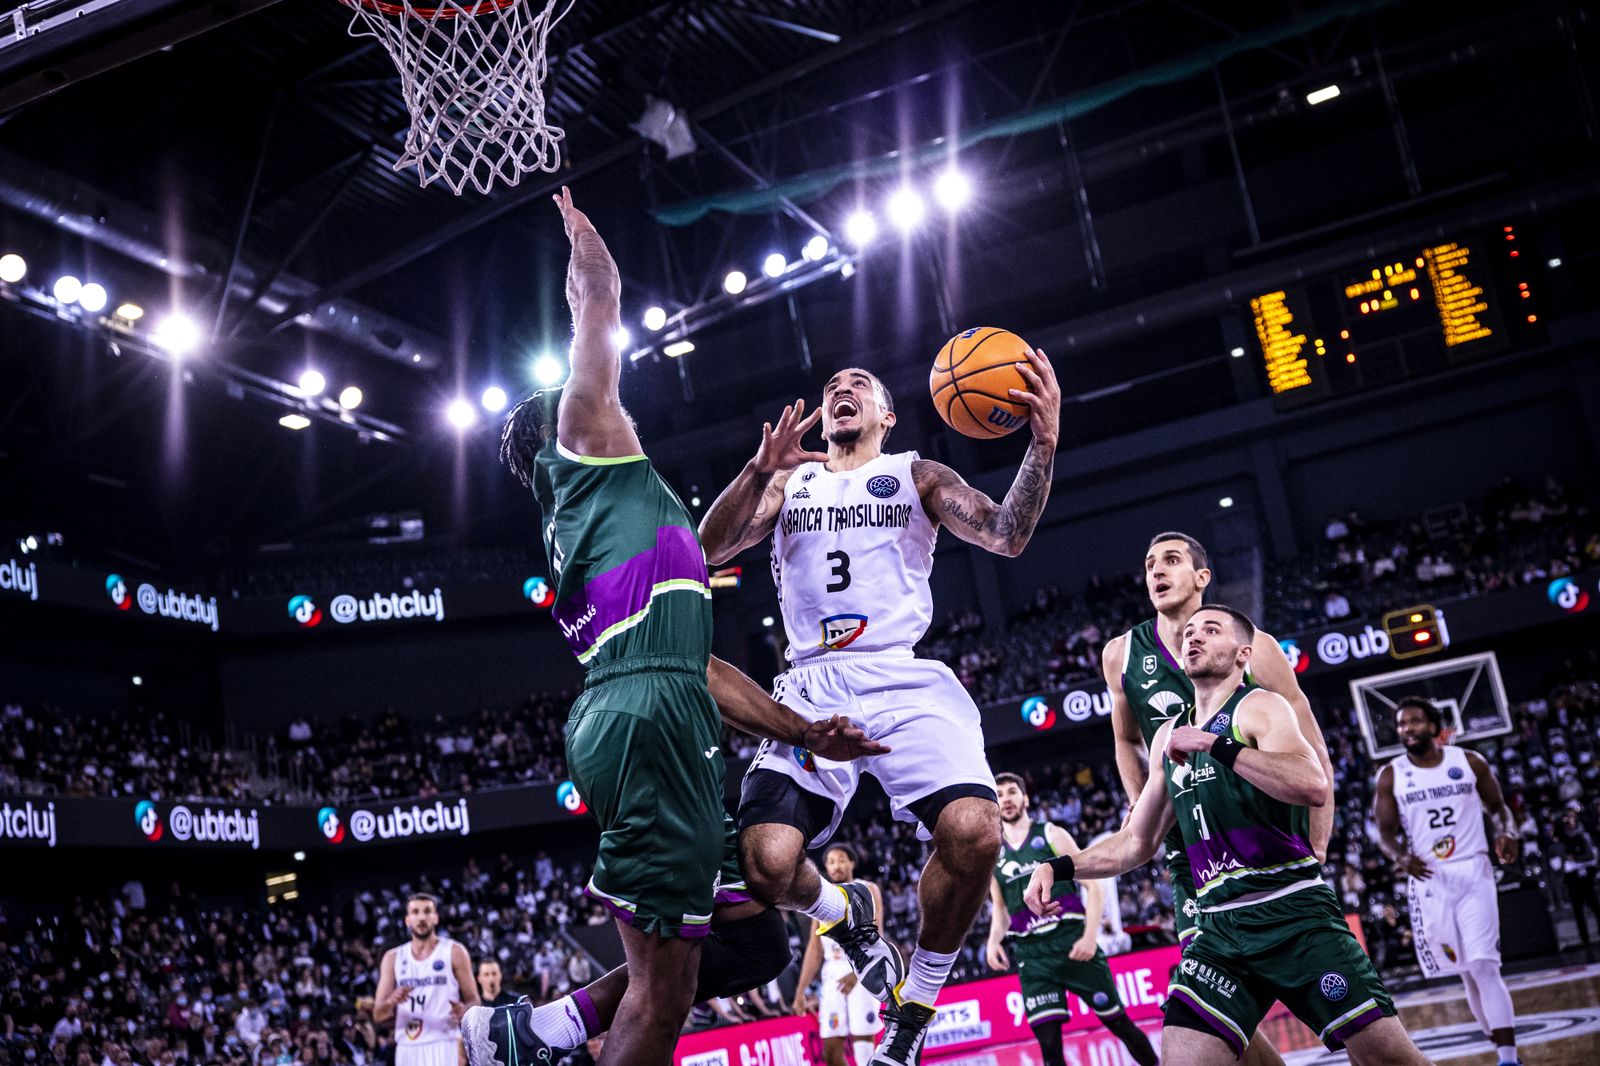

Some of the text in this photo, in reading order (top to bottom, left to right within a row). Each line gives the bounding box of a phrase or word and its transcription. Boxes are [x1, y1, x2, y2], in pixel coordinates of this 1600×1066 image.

[943, 498, 988, 532] Blessed
[826, 550, 851, 593] 3
[137, 583, 219, 632] @ubtcluj
[330, 588, 444, 623] @ubtcluj
[0, 801, 57, 847] tcluj
[170, 805, 260, 849] @ubtcluj
[350, 798, 470, 841] @ubtcluj
[1427, 807, 1456, 829] 22
[1199, 964, 1237, 993] MÁLAGA
[408, 995, 426, 1013] 14
